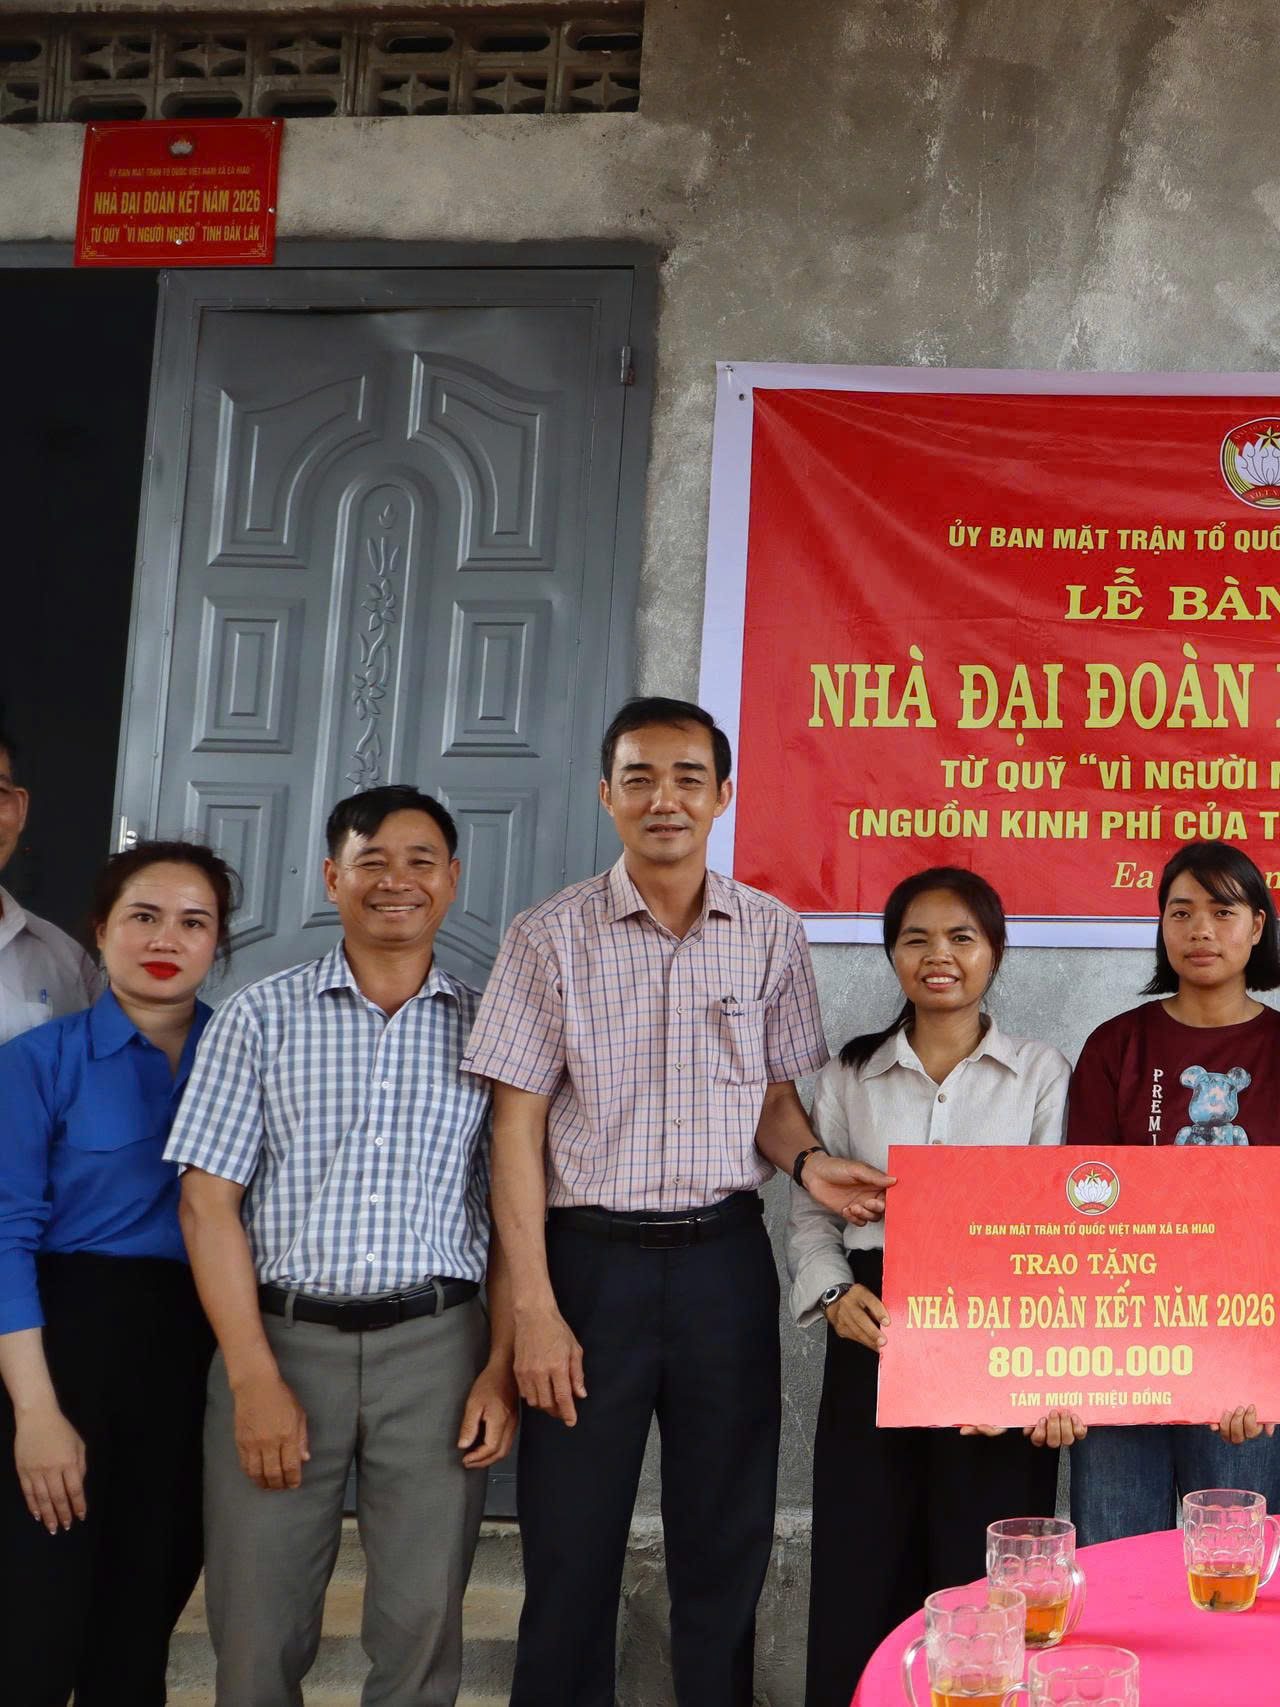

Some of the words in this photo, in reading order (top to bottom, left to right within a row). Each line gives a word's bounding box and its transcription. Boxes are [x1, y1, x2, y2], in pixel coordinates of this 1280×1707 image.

[93, 186, 118, 214] NHÀ
[178, 182, 200, 214] KẾT
[202, 185, 230, 213] NĂM
[232, 189, 261, 213] 2026
[948, 519, 982, 547] ỦY
[990, 527, 1044, 549] BAN
[1052, 524, 1109, 555] MẶT
[1117, 525, 1186, 555] TRẬN
[1194, 521, 1228, 551] TỔ
[1064, 567, 1144, 620] LỄ
[808, 644, 937, 728] NHÀ
[957, 663, 1064, 747] ĐẠI
[1084, 642, 1255, 730] ĐOÀN
[940, 754, 988, 789] TỪ
[996, 755, 1067, 793] QUỸ
[1079, 753, 1131, 790] “VÌ
[1144, 753, 1257, 790] NGƯỜI
[848, 799, 989, 840] (NGUỒN
[1000, 809, 1089, 840] KINH
[1101, 804, 1161, 840] PHÍ
[1174, 801, 1248, 840] CỦA
[1114, 861, 1153, 889] Ea
[1147, 1068, 1164, 1146] PREMI
[969, 1221, 983, 1236] ỦY
[984, 1224, 1007, 1236] BAN
[1009, 1222, 1032, 1238] MẶT
[1034, 1222, 1061, 1238] TRẬN
[1063, 1220, 1077, 1236] TỔ
[1078, 1221, 1106, 1236] QUỐC
[1108, 1222, 1130, 1238] VIỆT
[1132, 1223, 1157, 1235] NAM
[1159, 1221, 1173, 1235] XÃ
[1175, 1223, 1189, 1235] EA
[1191, 1223, 1216, 1234] HIAO
[1009, 1253, 1079, 1276] TRAO
[1087, 1247, 1158, 1280] TẶNG
[904, 1286, 960, 1329] NHÀ
[967, 1295, 1012, 1337] ĐẠI
[1018, 1285, 1088, 1329] ĐOÀN
[1094, 1279, 1146, 1329] KẾT
[1153, 1285, 1209, 1329] NĂM
[1216, 1293, 1276, 1328] 2026
[986, 1343, 1194, 1378] 80.000.000
[1009, 1389, 1041, 1407] TÁM
[1044, 1391, 1083, 1407] MƯƠI
[1087, 1388, 1128, 1409] TRIỆU
[1131, 1386, 1172, 1406] ĐỒNG
